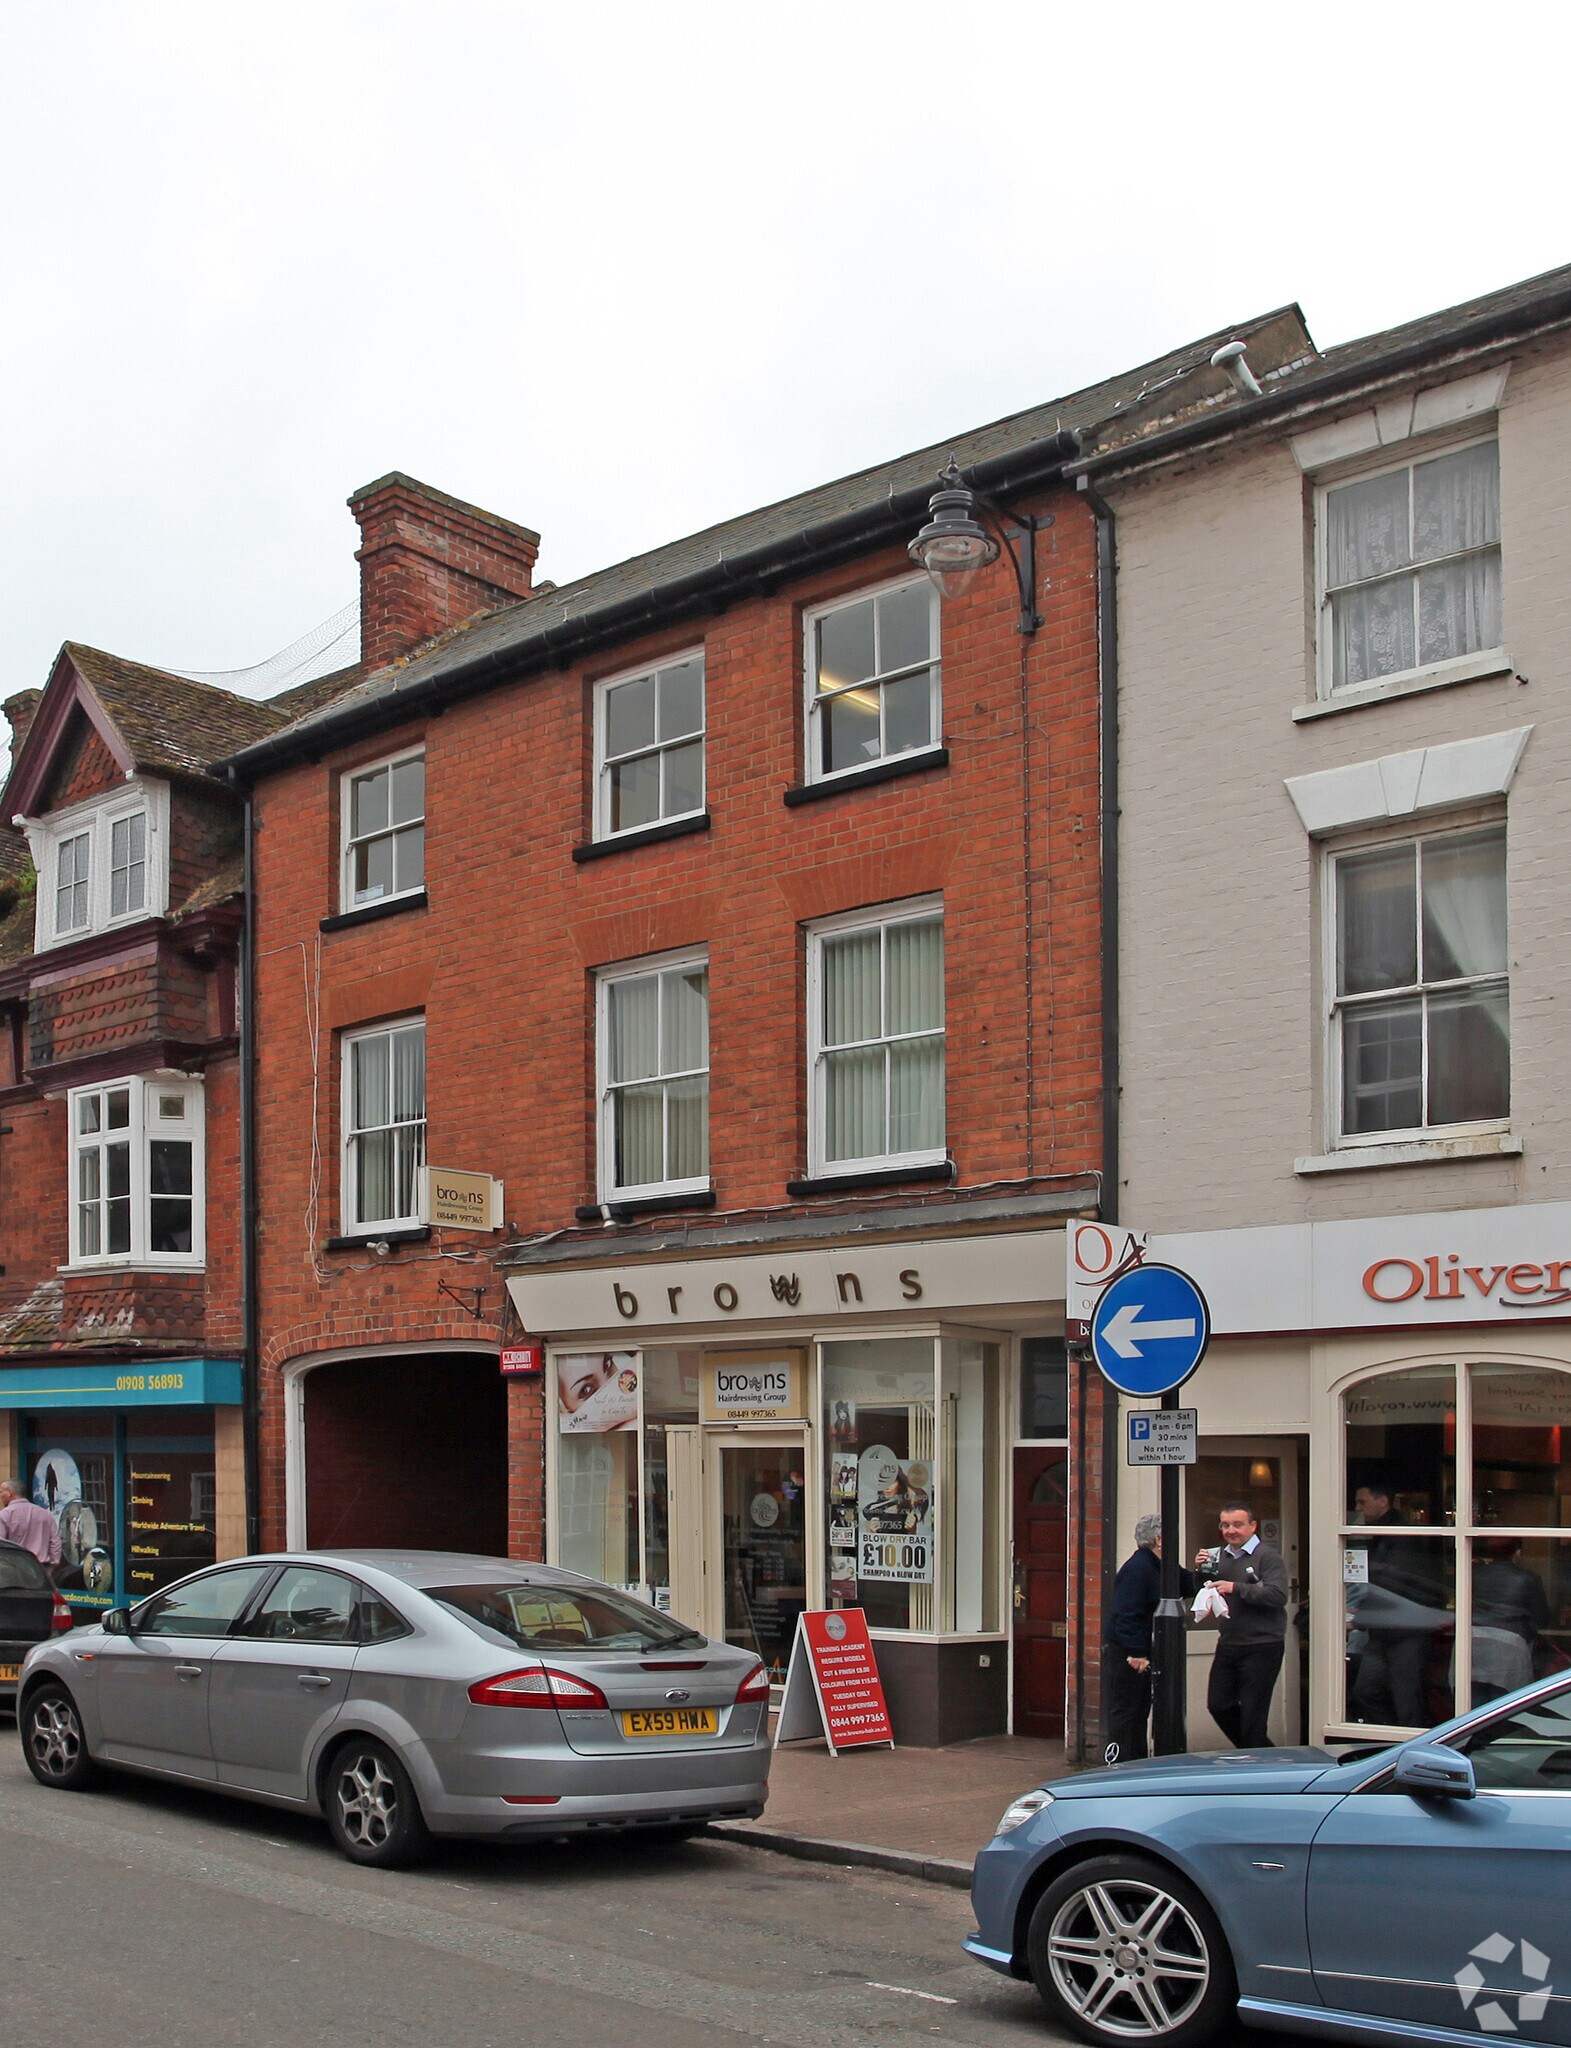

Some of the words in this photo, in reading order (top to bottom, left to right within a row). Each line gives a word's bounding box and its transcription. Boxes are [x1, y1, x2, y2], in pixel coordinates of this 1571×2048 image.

[613, 1269, 923, 1318] browns
[116, 1376, 145, 1391] 01908
[148, 1374, 184, 1390] 568913
[718, 1370, 787, 1391] browns
[718, 1392, 762, 1403] Hairdressing
[764, 1391, 787, 1404] Group
[728, 1410, 749, 1418] 08449
[751, 1409, 776, 1418] 997365
[1177, 1412, 1191, 1420] Sat
[1134, 1420, 1147, 1438] P
[1182, 1424, 1193, 1432] pm
[1170, 1433, 1188, 1441] mins
[1144, 1445, 1155, 1453] No
[1138, 1453, 1162, 1461] within
[1167, 1453, 1186, 1461] hour
[131, 1472, 171, 1482] Mountaineering
[131, 1496, 154, 1506] Climbing
[131, 1521, 159, 1530] Worldwide
[160, 1522, 188, 1531] Adventure
[189, 1523, 206, 1532] Travel
[863, 1534, 887, 1543] BLOW
[889, 1535, 906, 1544] DRY
[909, 1536, 927, 1545] BAR
[131, 1545, 160, 1556] Hillwalking
[863, 1543, 926, 1569] £10.00
[131, 1570, 155, 1581] Camping
[863, 1569, 891, 1578] SHAMPOO
[897, 1571, 913, 1579] BLOW
[815, 1645, 840, 1653] TRAINING
[841, 1643, 866, 1651] ACADEMY
[832, 1691, 856, 1700] TUESDAY
[856, 1690, 871, 1698] ONLY
[846, 1701, 879, 1711] SUPERVISED
[631, 1713, 675, 1732] EX59
[679, 1711, 710, 1730] HWA
[831, 1717, 850, 1727] 0844
[850, 1715, 865, 1724] 999
[865, 1713, 885, 1723] 7365
